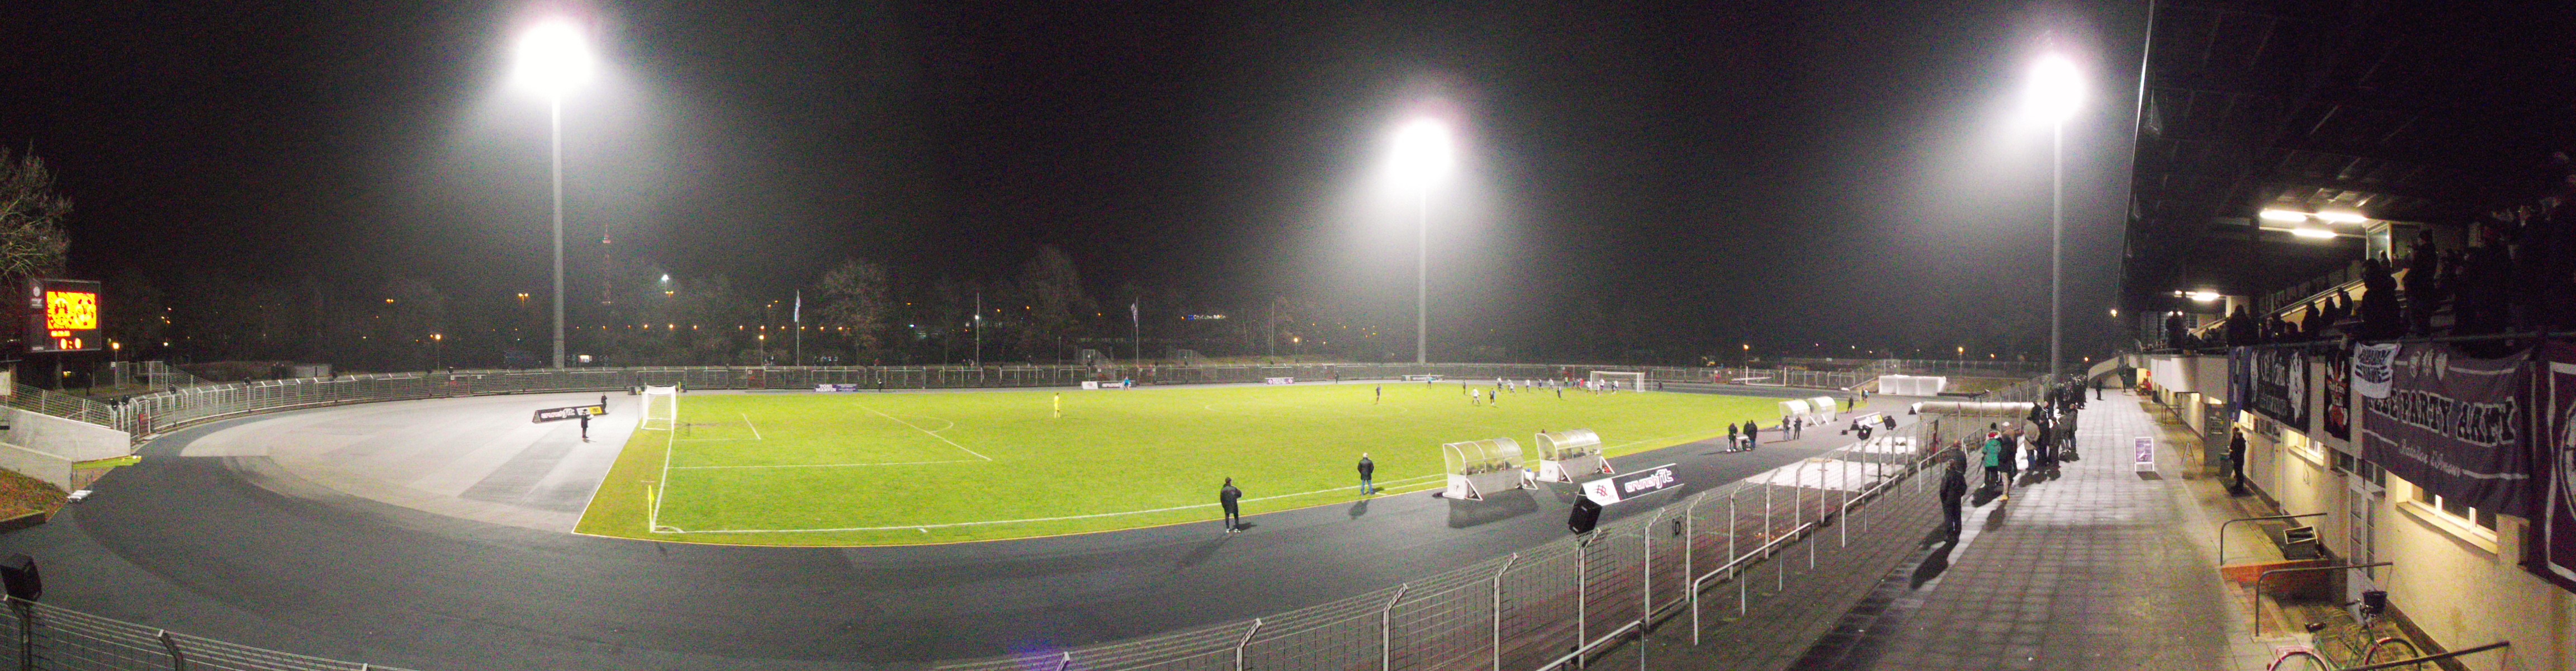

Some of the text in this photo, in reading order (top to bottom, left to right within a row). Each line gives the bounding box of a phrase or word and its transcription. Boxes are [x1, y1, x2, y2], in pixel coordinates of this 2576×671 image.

[541, 408, 575, 418] crunchfit
[2399, 390, 2455, 437] PARTY
[2456, 395, 2517, 447] ARMY
[1625, 467, 1674, 493] crunchfit
